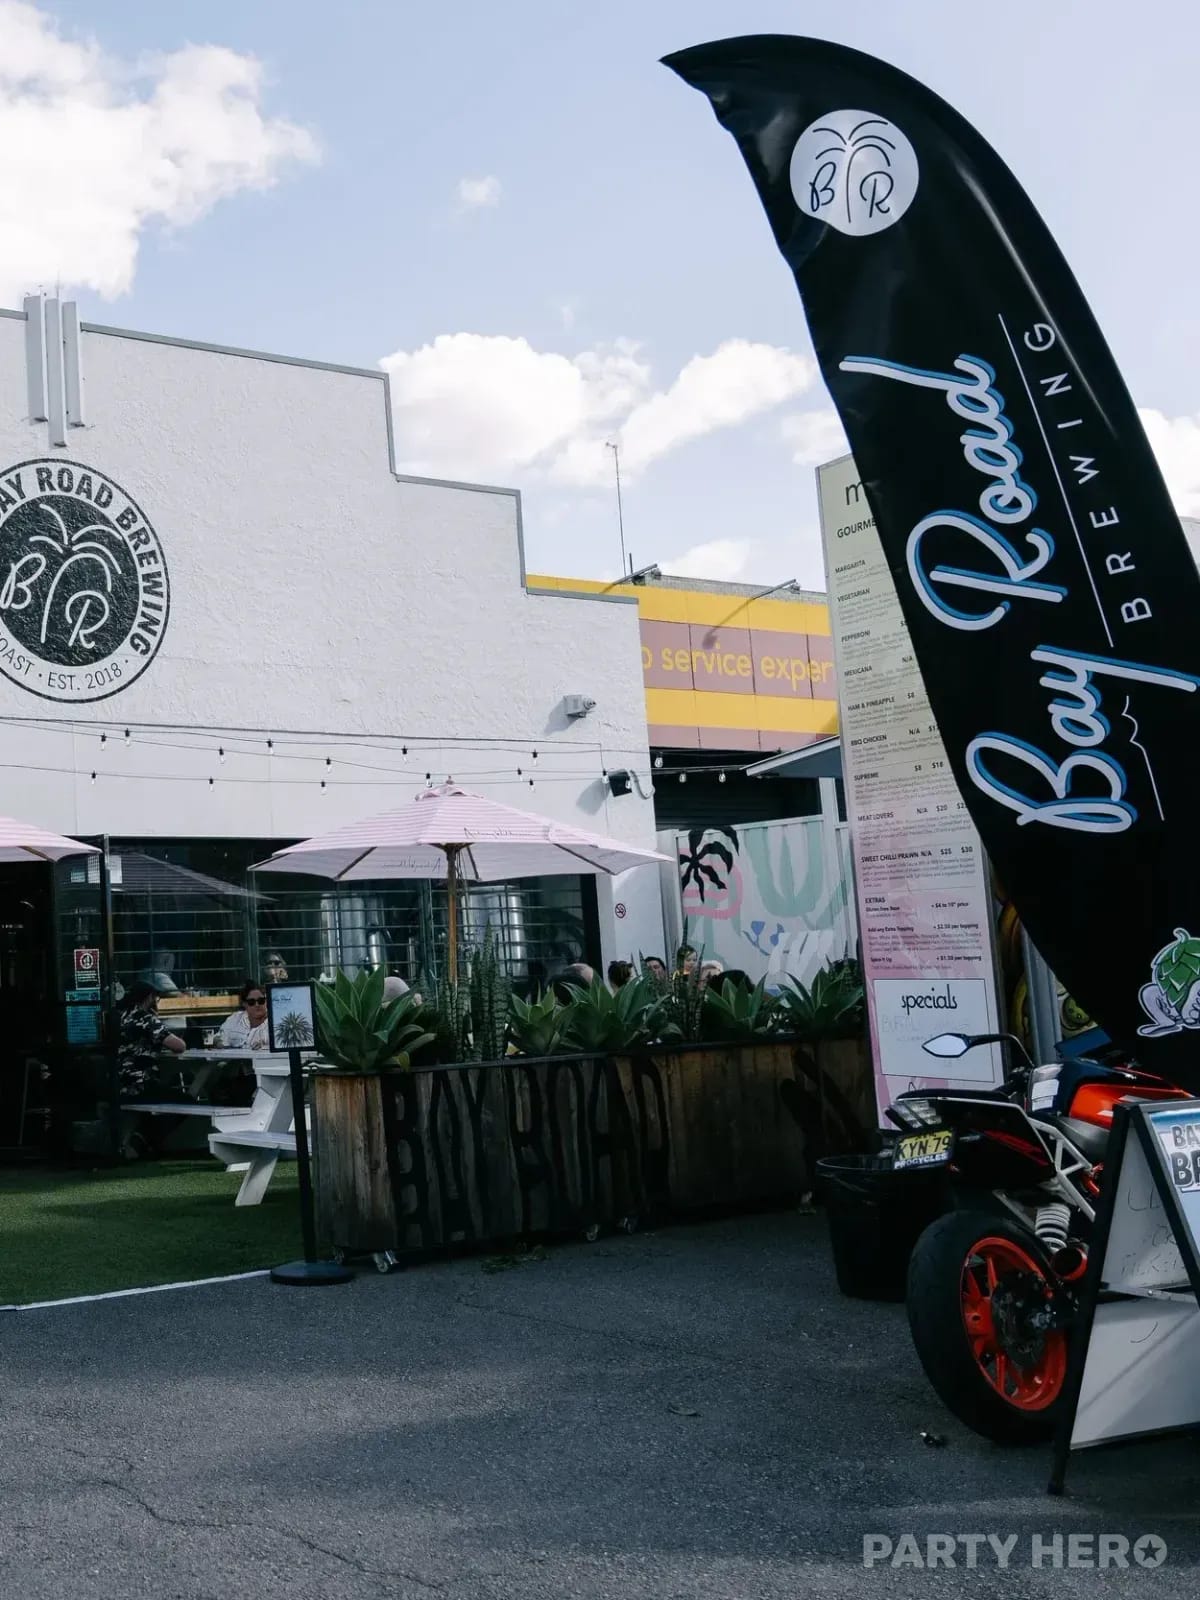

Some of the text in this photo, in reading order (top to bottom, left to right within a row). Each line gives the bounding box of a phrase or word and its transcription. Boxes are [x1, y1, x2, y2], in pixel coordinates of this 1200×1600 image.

[1023, 322, 1153, 624] BREWING
[839, 353, 1068, 631] Road
[35, 467, 114, 510] ROAD
[115, 506, 165, 656] BREWING
[835, 559, 866, 574] MARGARITA
[837, 588, 871, 602] VEGETARIAN
[841, 630, 871, 643] PEPPERONI
[661, 641, 752, 678] service
[760, 656, 834, 692] exper
[844, 665, 873, 677] MEXICANA
[47, 672, 81, 691] EST.
[85, 662, 123, 689] 2018
[866, 696, 896, 709] PINEAPPLE
[908, 727, 920, 735] N/A
[850, 734, 888, 747] BBQ CHICKEN
[965, 644, 1200, 833] Bay
[853, 772, 879, 781] SUPREME
[857, 811, 895, 821] MEAT LOVERS
[861, 855, 879, 863] SWEET
[879, 854, 897, 862] CHILLI
[897, 852, 919, 860] PRAWN
[901, 984, 958, 1016] specials
